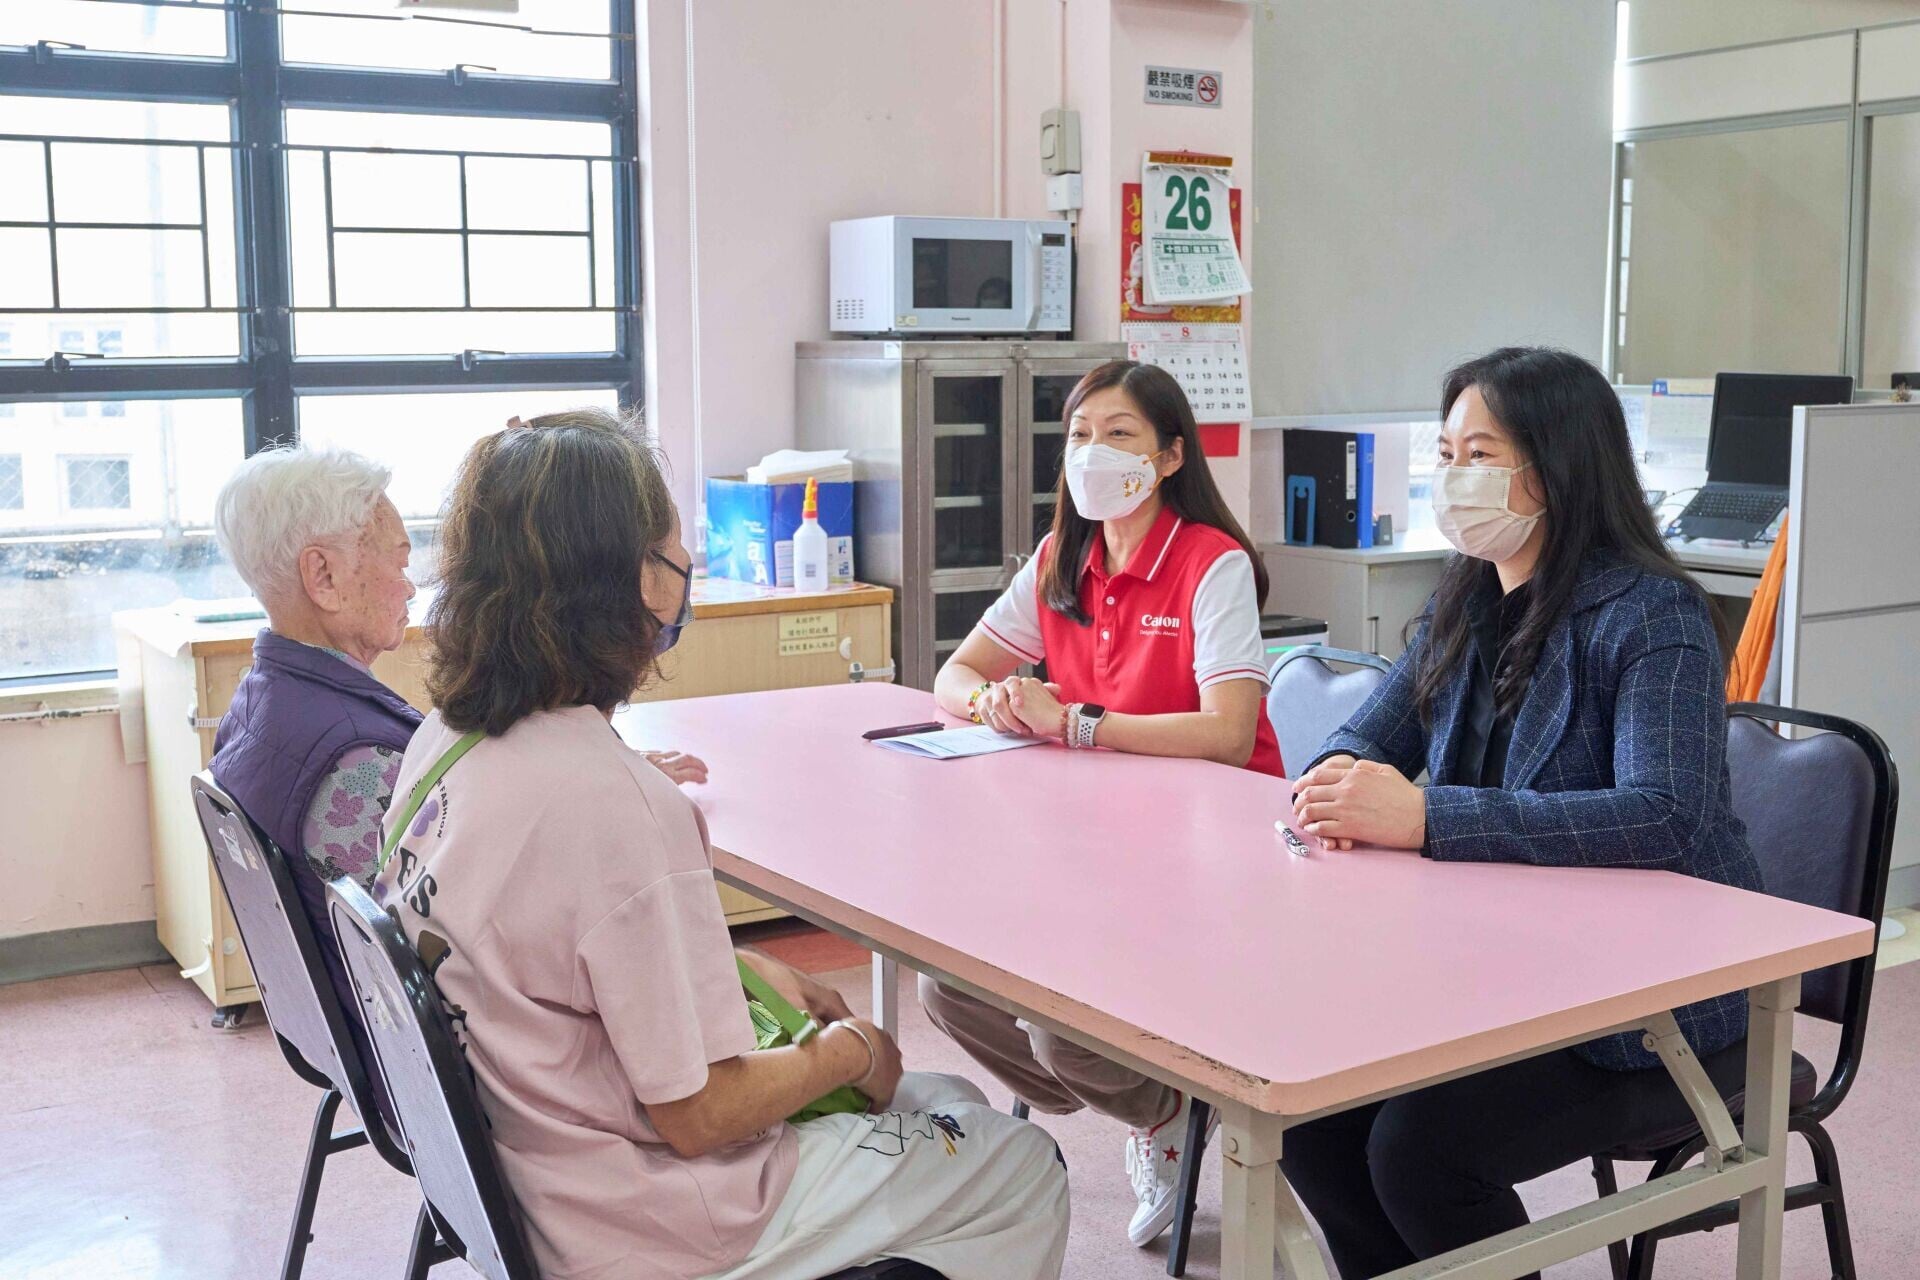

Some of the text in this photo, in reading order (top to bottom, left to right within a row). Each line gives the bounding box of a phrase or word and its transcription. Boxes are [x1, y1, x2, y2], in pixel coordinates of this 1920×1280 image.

[1147, 70, 1195, 90] 嚴禁吸煙
[1149, 90, 1193, 101] NO SMOKING
[1165, 175, 1212, 231] 26
[1182, 327, 1190, 337] 8
[437, 785, 448, 838] FASHION
